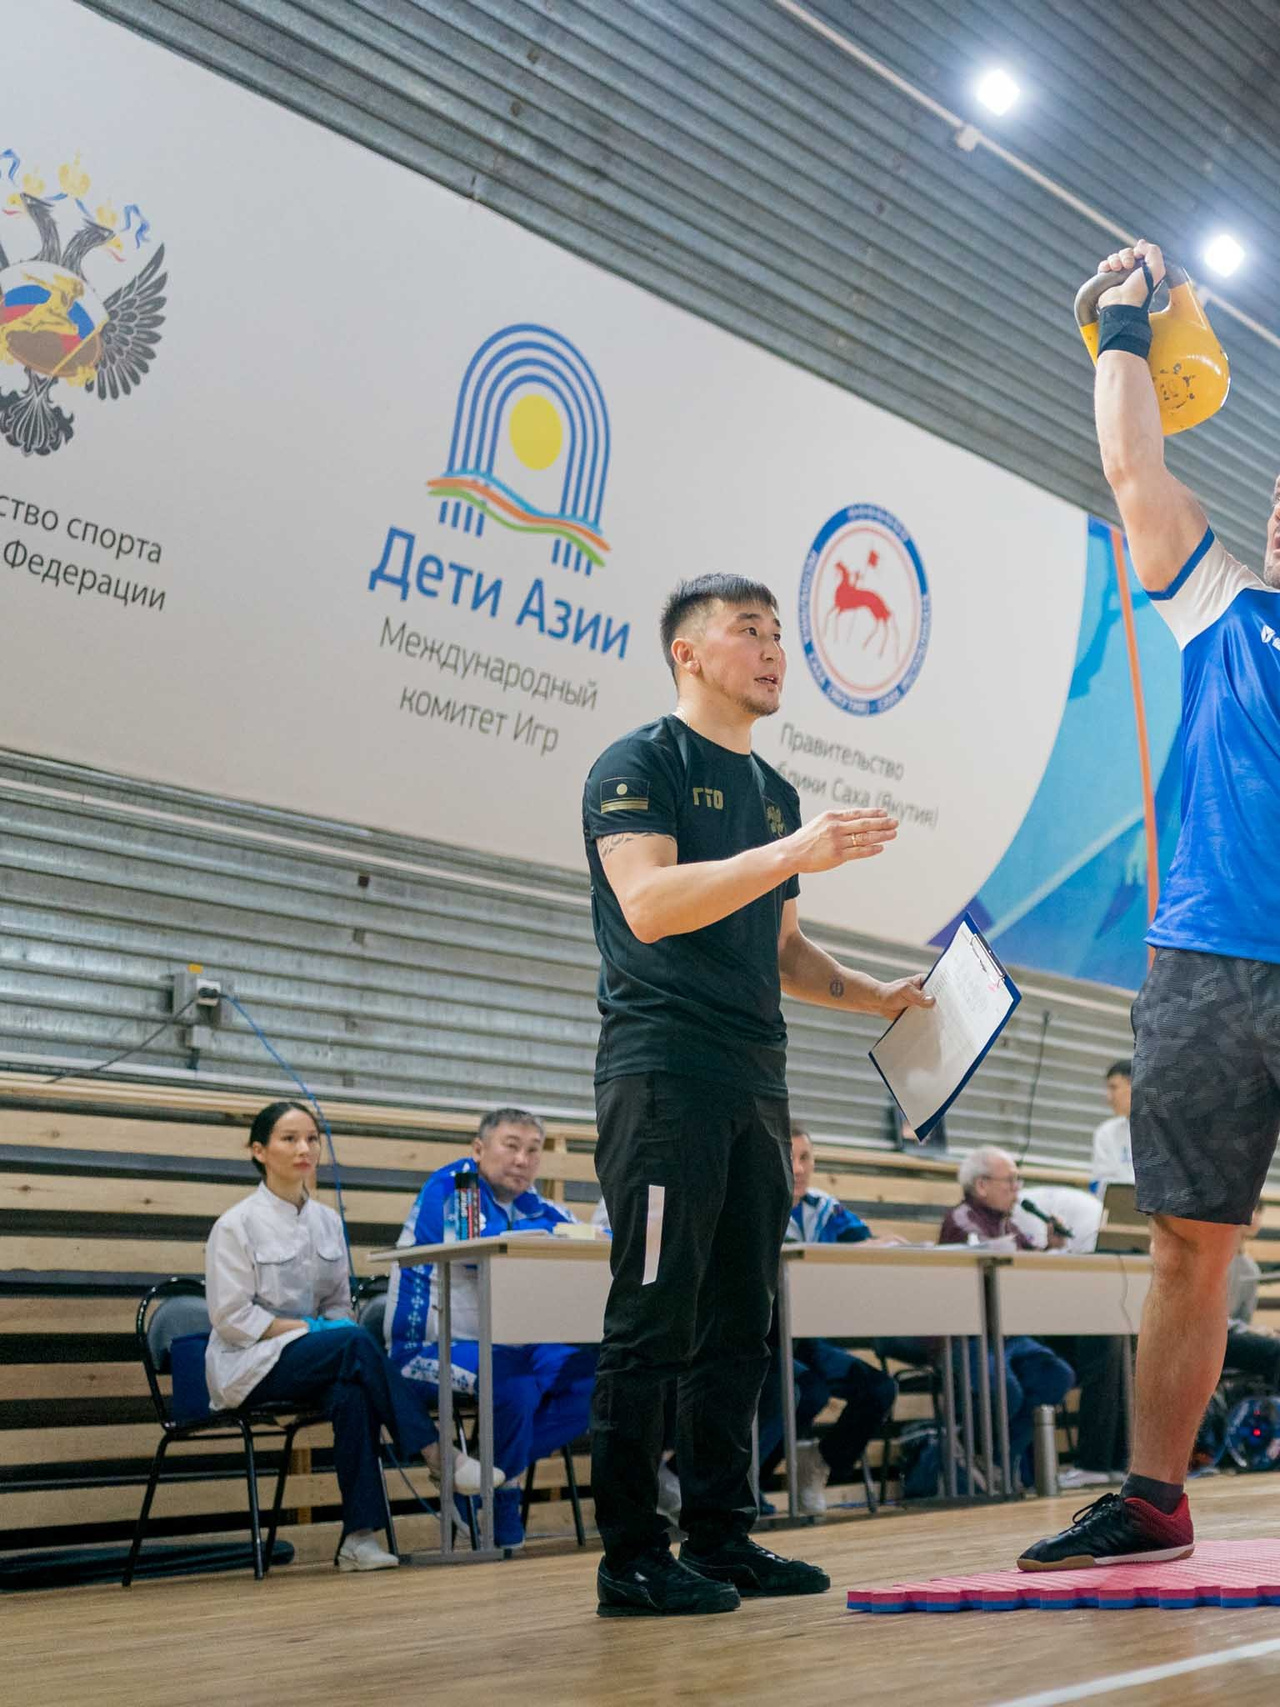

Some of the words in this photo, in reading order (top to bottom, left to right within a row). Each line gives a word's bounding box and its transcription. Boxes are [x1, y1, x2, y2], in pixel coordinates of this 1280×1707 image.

[67, 518, 162, 564] спорта
[4, 539, 166, 611] Федерации
[368, 525, 503, 618] Дети
[515, 577, 631, 660] Азии
[379, 616, 598, 711] Международный
[399, 686, 508, 737] комитет
[513, 711, 560, 757] Игр
[780, 721, 904, 781] Правительство
[692, 787, 724, 811] ГТО
[832, 777, 870, 807] Саха
